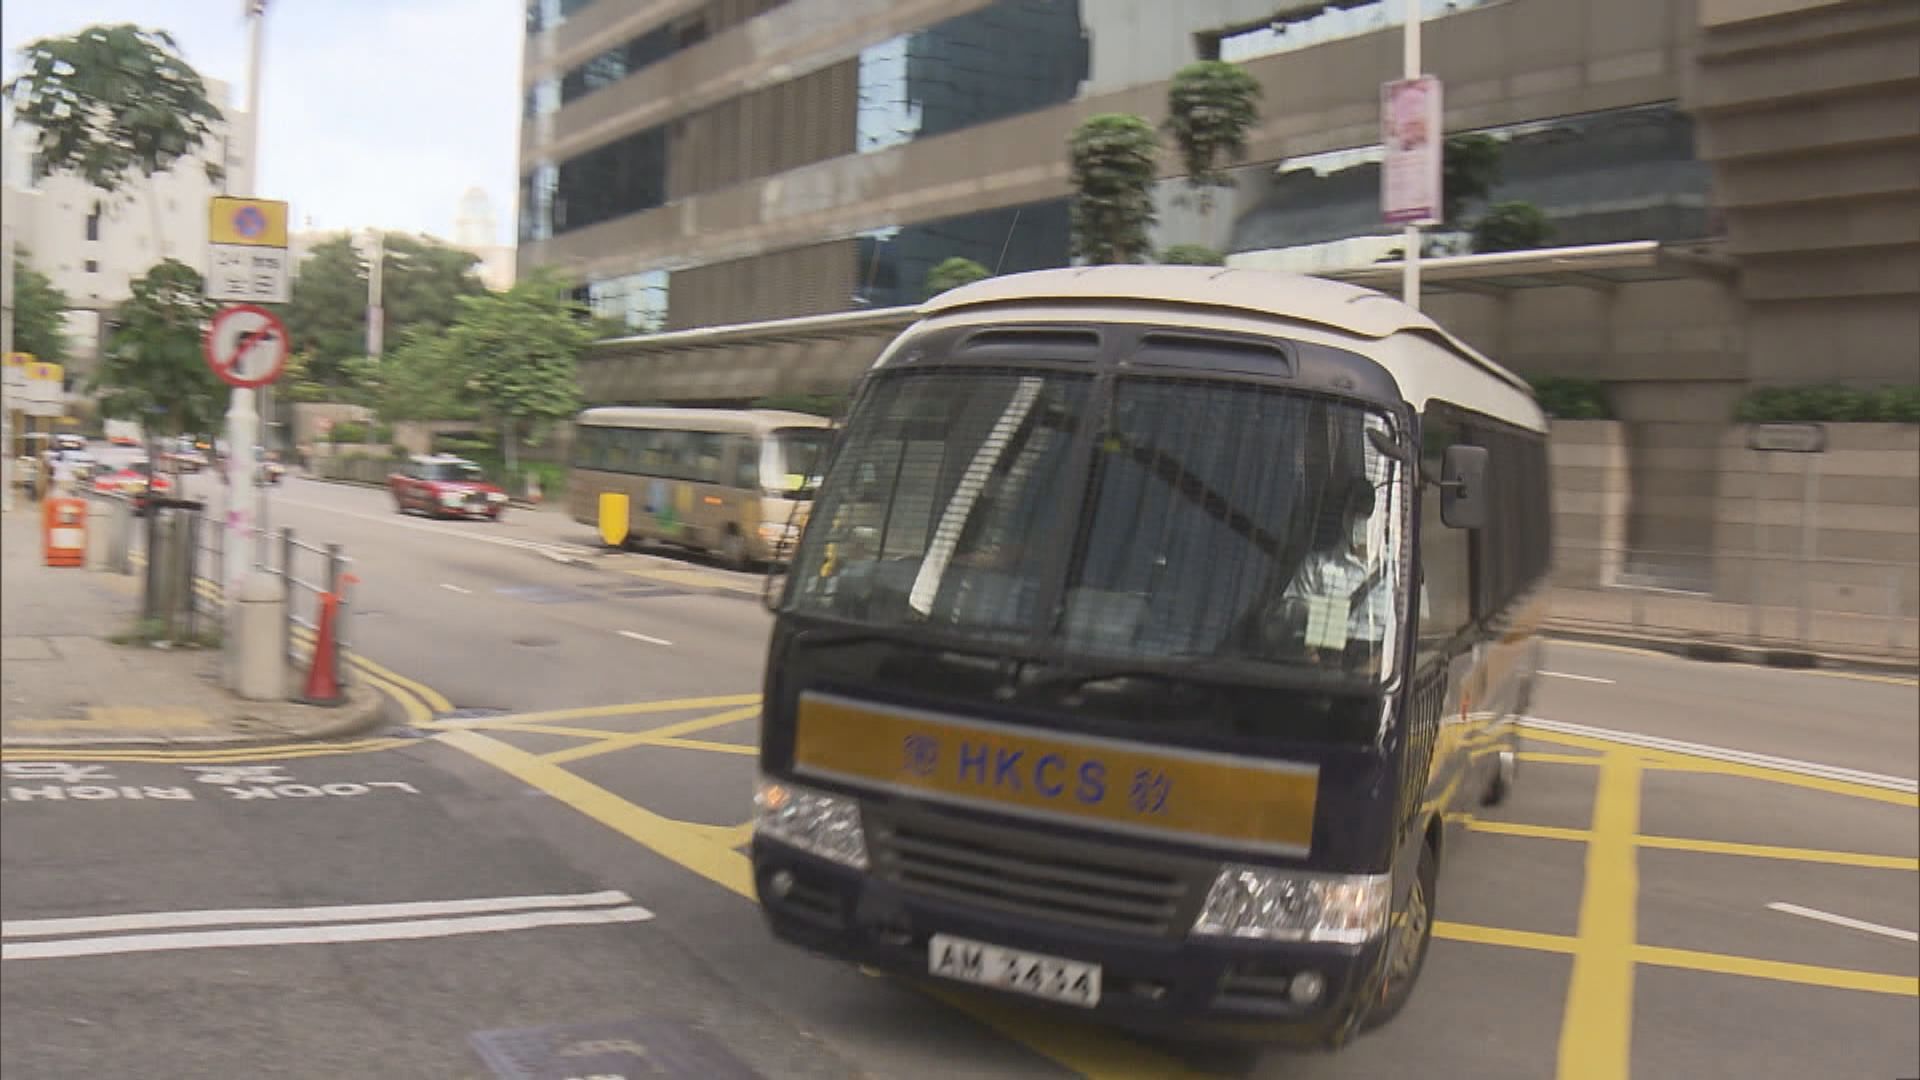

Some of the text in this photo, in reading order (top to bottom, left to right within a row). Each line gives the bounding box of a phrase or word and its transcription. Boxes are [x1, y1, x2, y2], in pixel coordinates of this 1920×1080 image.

[1, 781, 421, 801] LOOK RIGH
[957, 742, 1107, 805] HKCS
[935, 943, 1092, 1002] AM 3434
